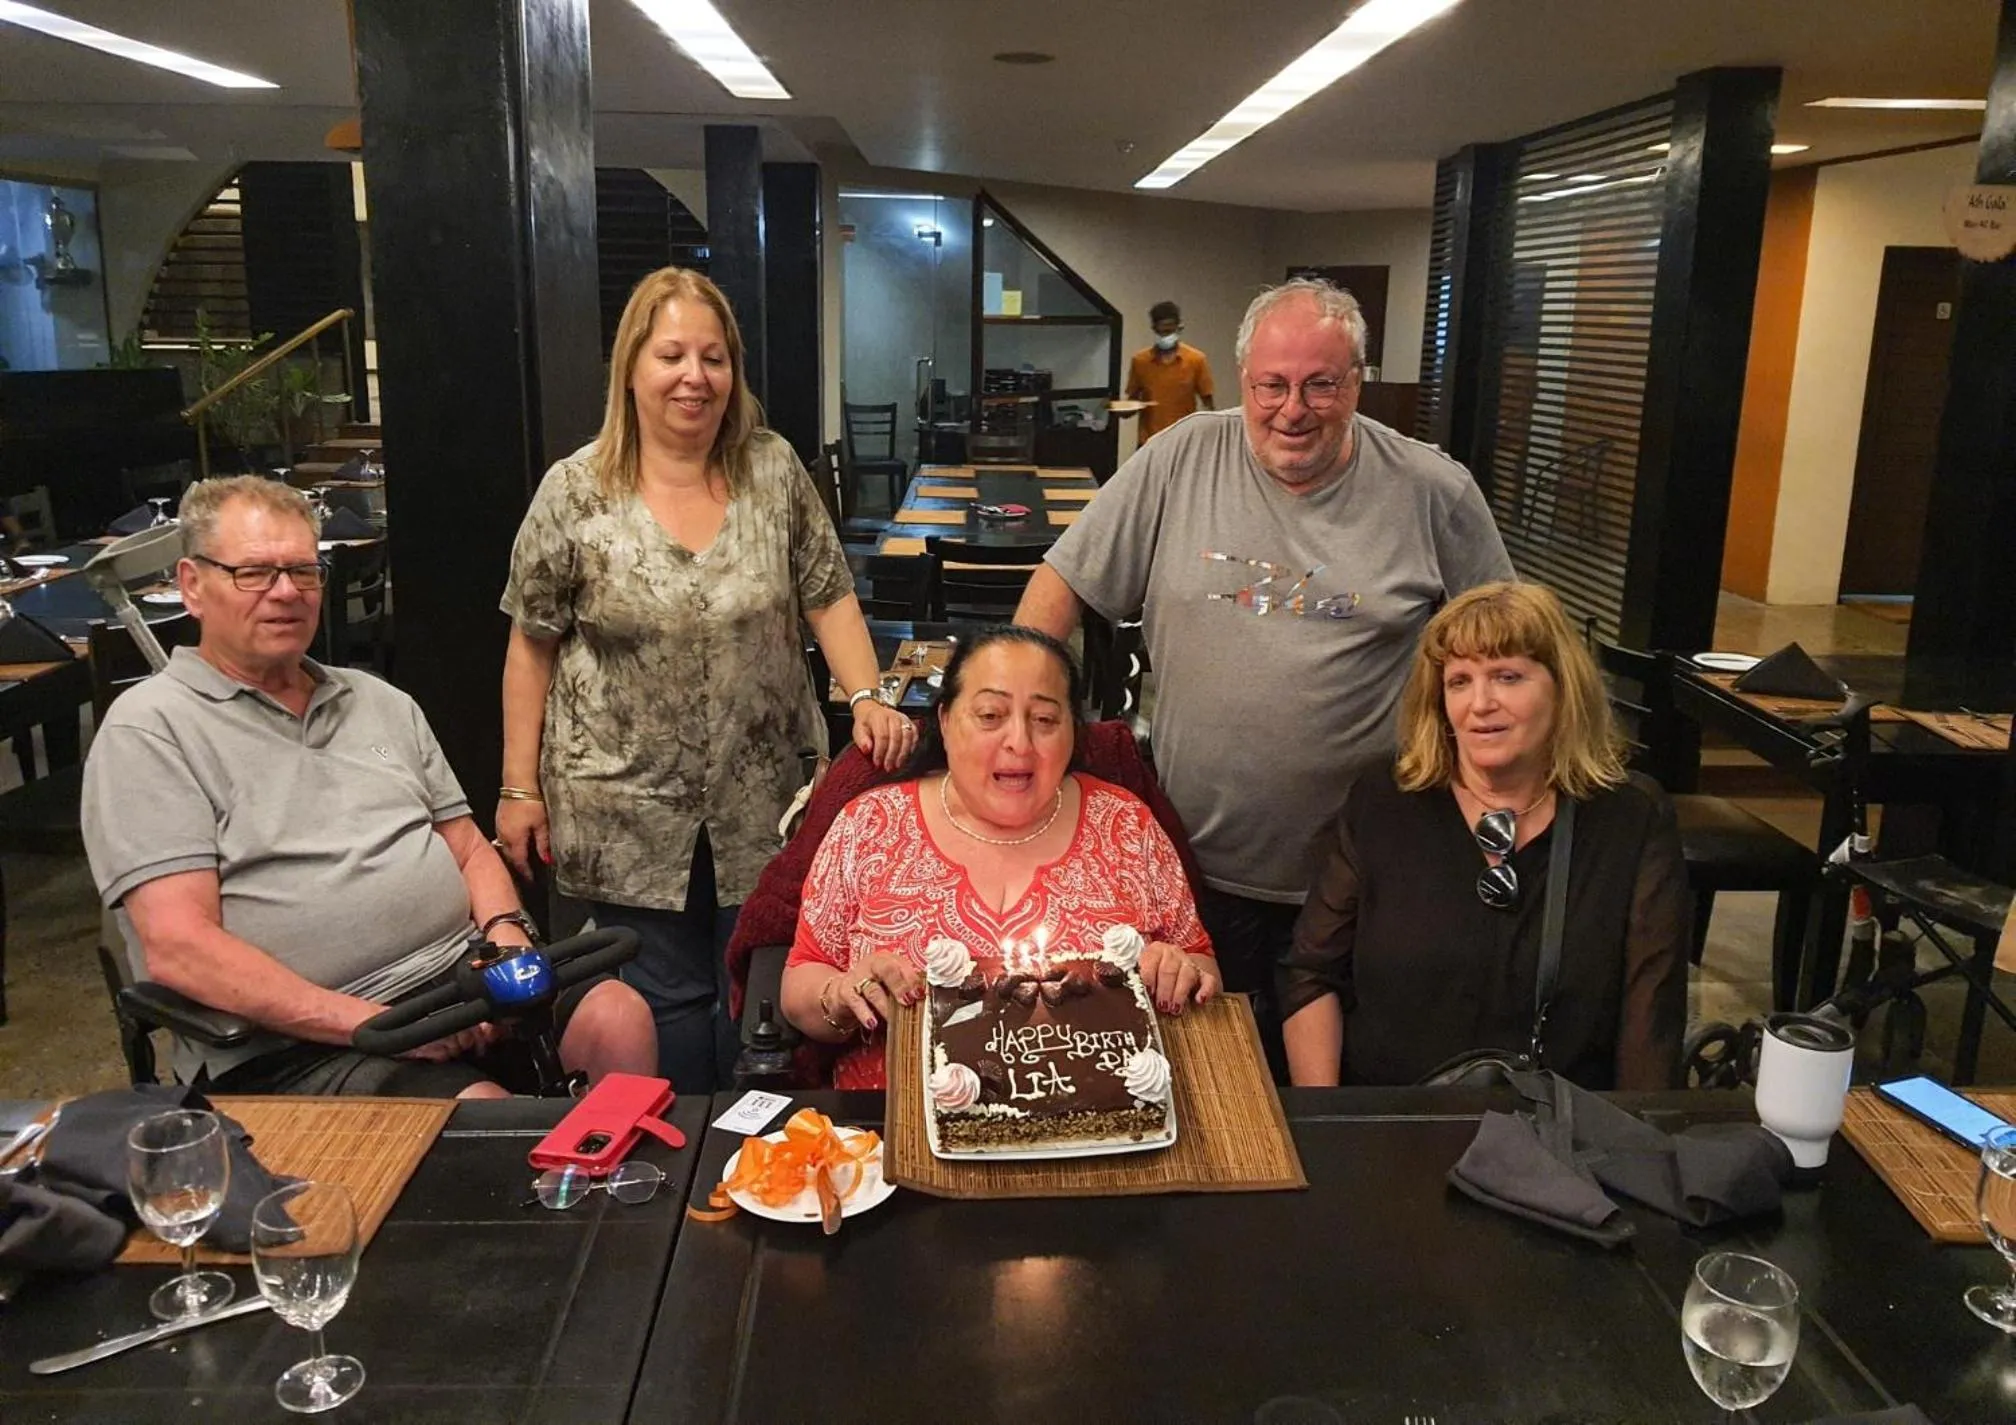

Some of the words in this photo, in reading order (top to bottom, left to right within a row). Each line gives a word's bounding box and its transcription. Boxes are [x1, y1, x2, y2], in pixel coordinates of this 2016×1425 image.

[985, 1020, 1073, 1064] HAPPY
[1066, 1031, 1139, 1060] BIRTH
[1009, 1061, 1076, 1100] LIA
